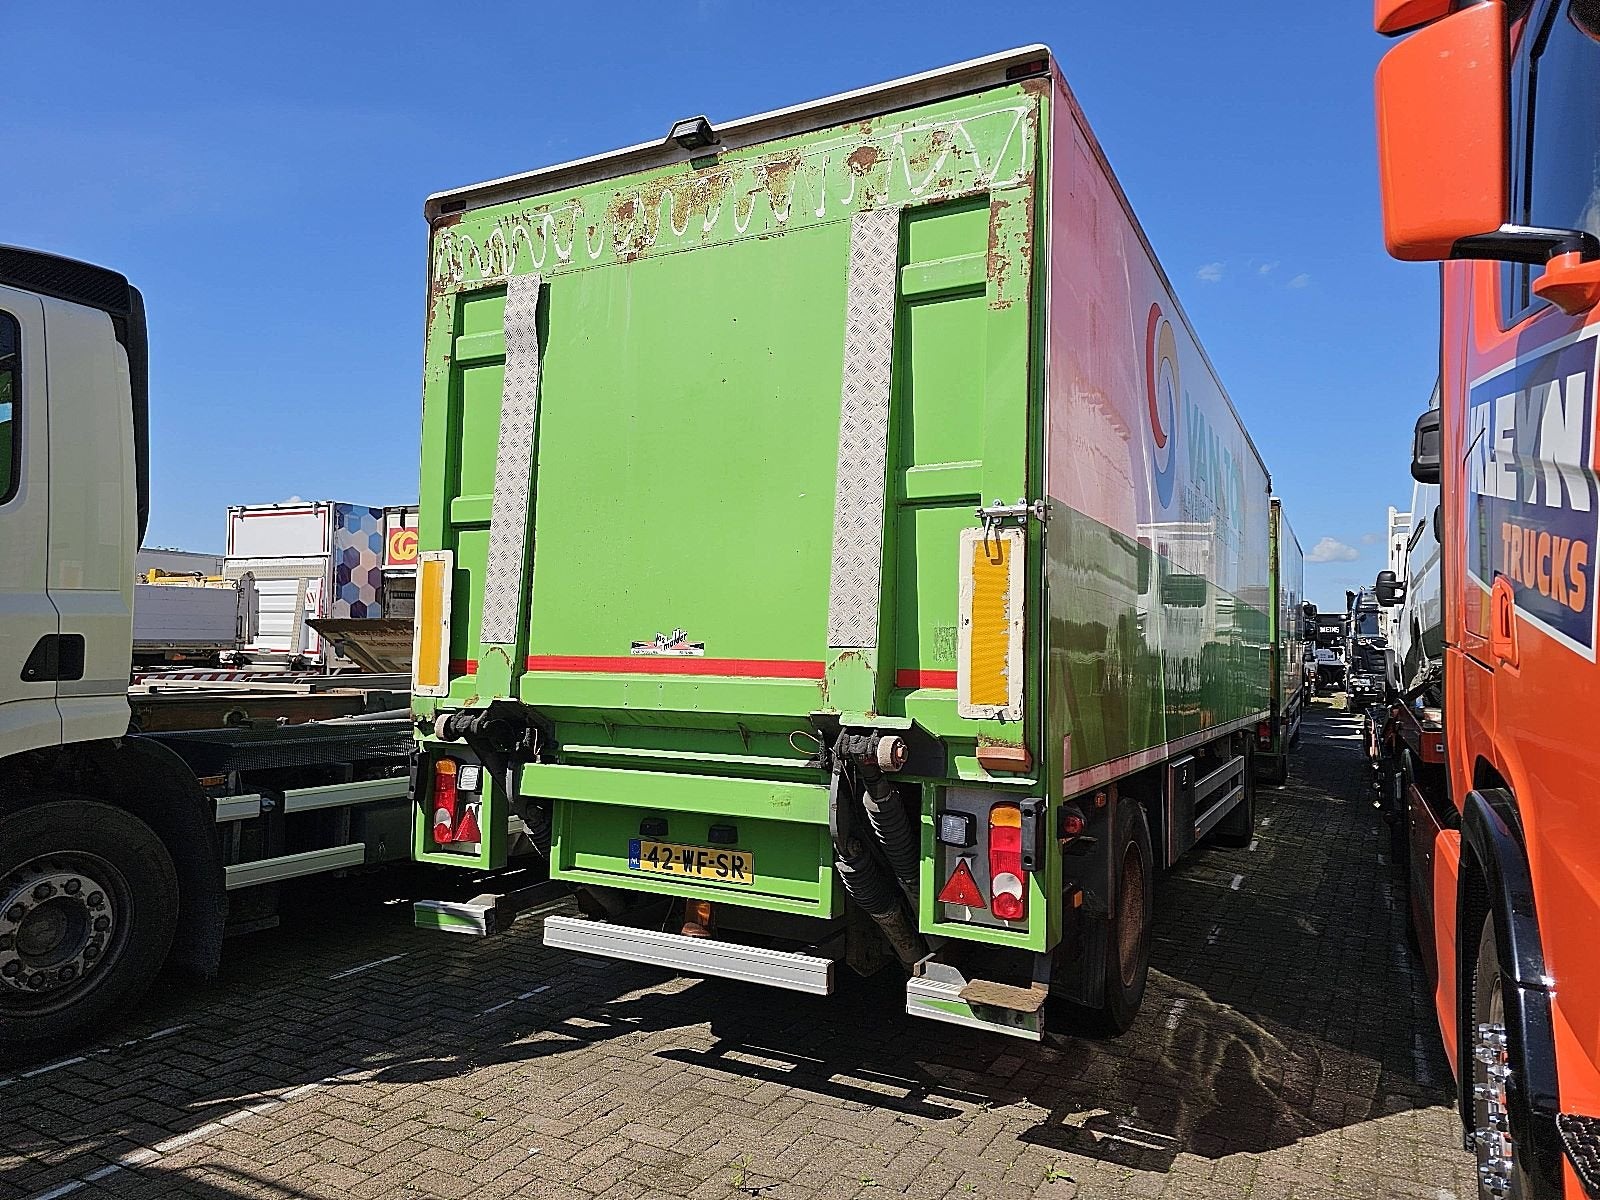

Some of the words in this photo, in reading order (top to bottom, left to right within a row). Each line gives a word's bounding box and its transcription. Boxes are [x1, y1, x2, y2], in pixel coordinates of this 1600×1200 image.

[1471, 371, 1591, 512] KLEYN
[1502, 522, 1588, 613] TRUCKS
[630, 857, 640, 865] NL
[647, 846, 745, 879] 42-WF-SR
